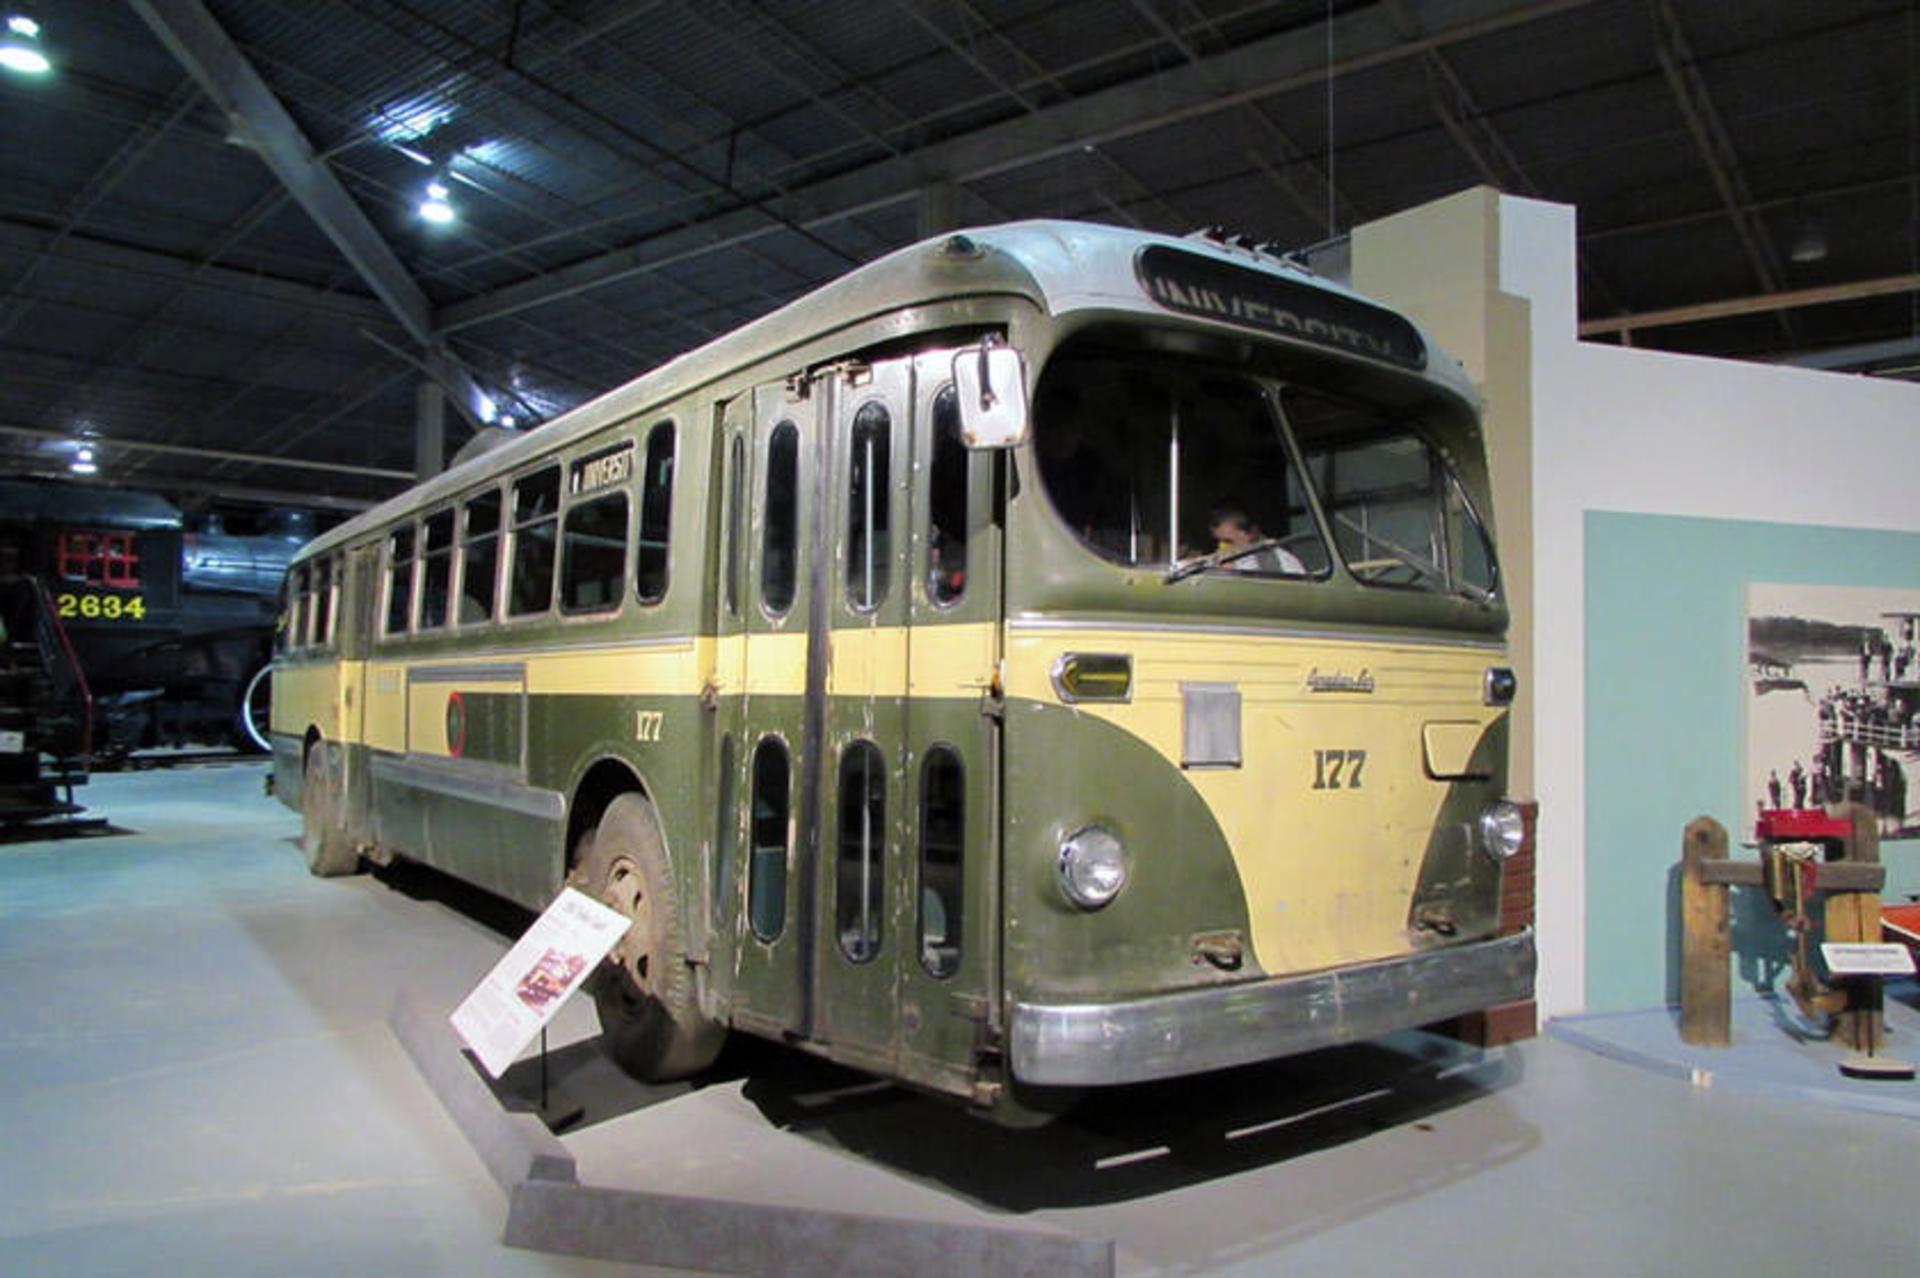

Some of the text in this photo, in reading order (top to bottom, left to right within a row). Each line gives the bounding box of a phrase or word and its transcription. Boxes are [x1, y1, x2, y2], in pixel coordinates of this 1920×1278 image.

[57, 594, 146, 619] 2634
[636, 710, 663, 741] 177
[1312, 749, 1366, 789] 177
